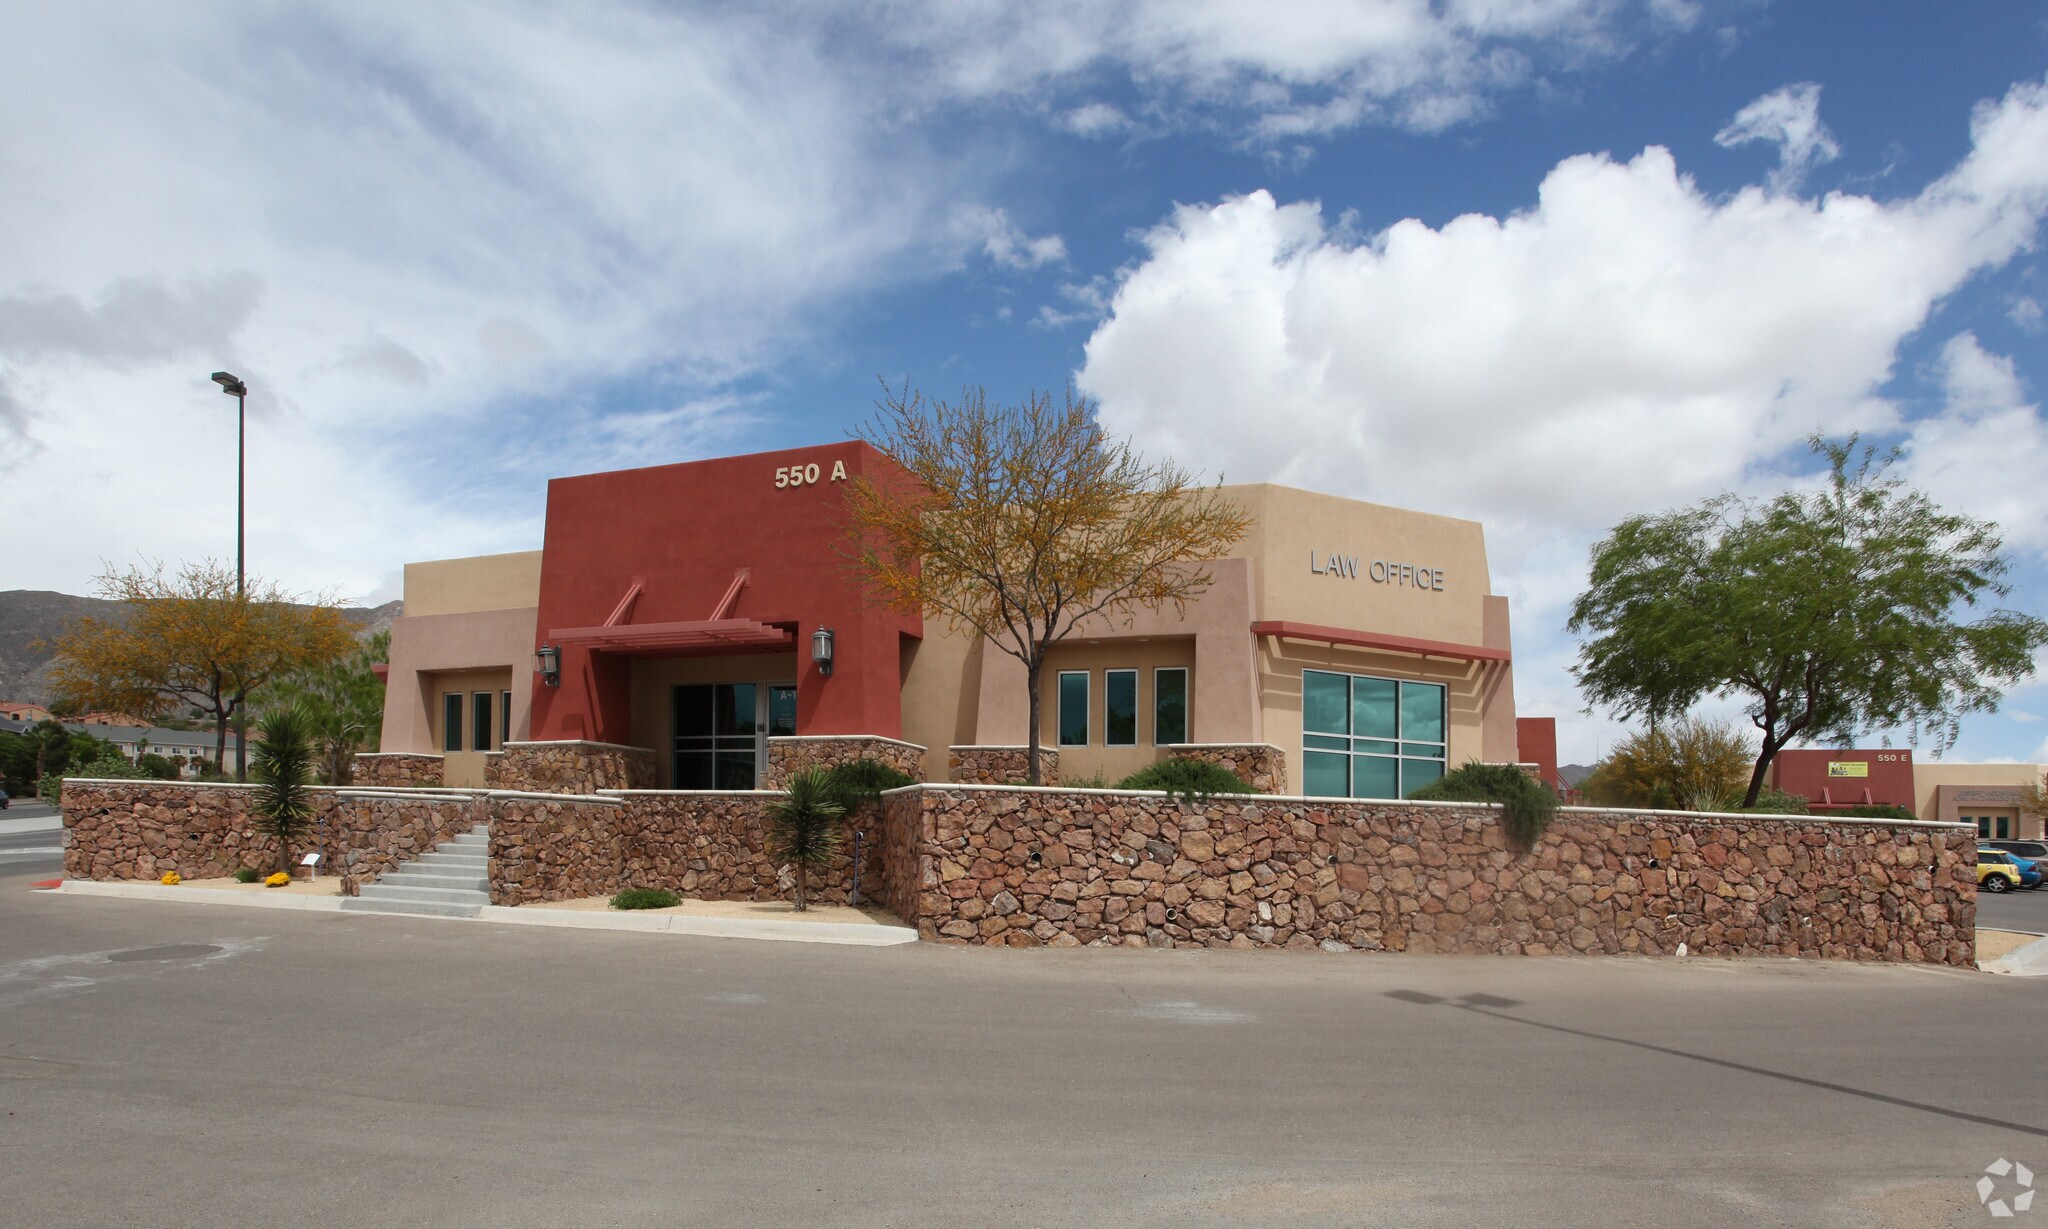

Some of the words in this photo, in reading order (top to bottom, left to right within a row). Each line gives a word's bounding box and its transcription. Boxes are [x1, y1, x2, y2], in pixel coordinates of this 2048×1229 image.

[775, 463, 820, 488] 550
[831, 460, 847, 481] A
[1311, 550, 1360, 579] LAW
[1369, 560, 1444, 592] OFFICE
[1877, 754, 1897, 762] 550
[1901, 754, 1907, 762] E
